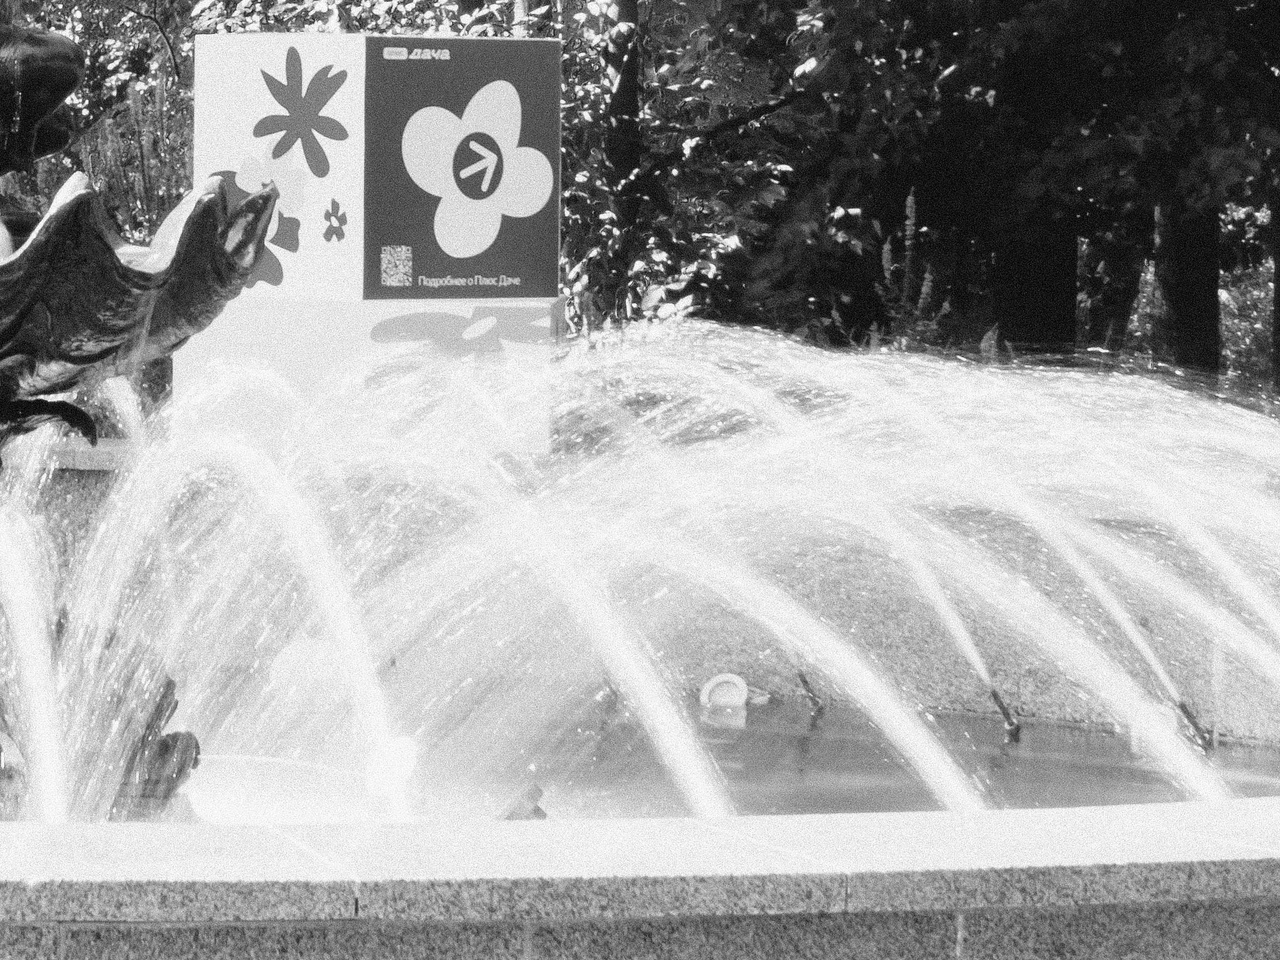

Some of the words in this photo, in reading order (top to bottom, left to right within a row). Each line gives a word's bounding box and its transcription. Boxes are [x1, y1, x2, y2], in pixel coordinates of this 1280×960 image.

[418, 275, 467, 288] Подробнее
[467, 278, 474, 286] о
[474, 274, 498, 286] Плюс
[498, 274, 521, 287] Даче
